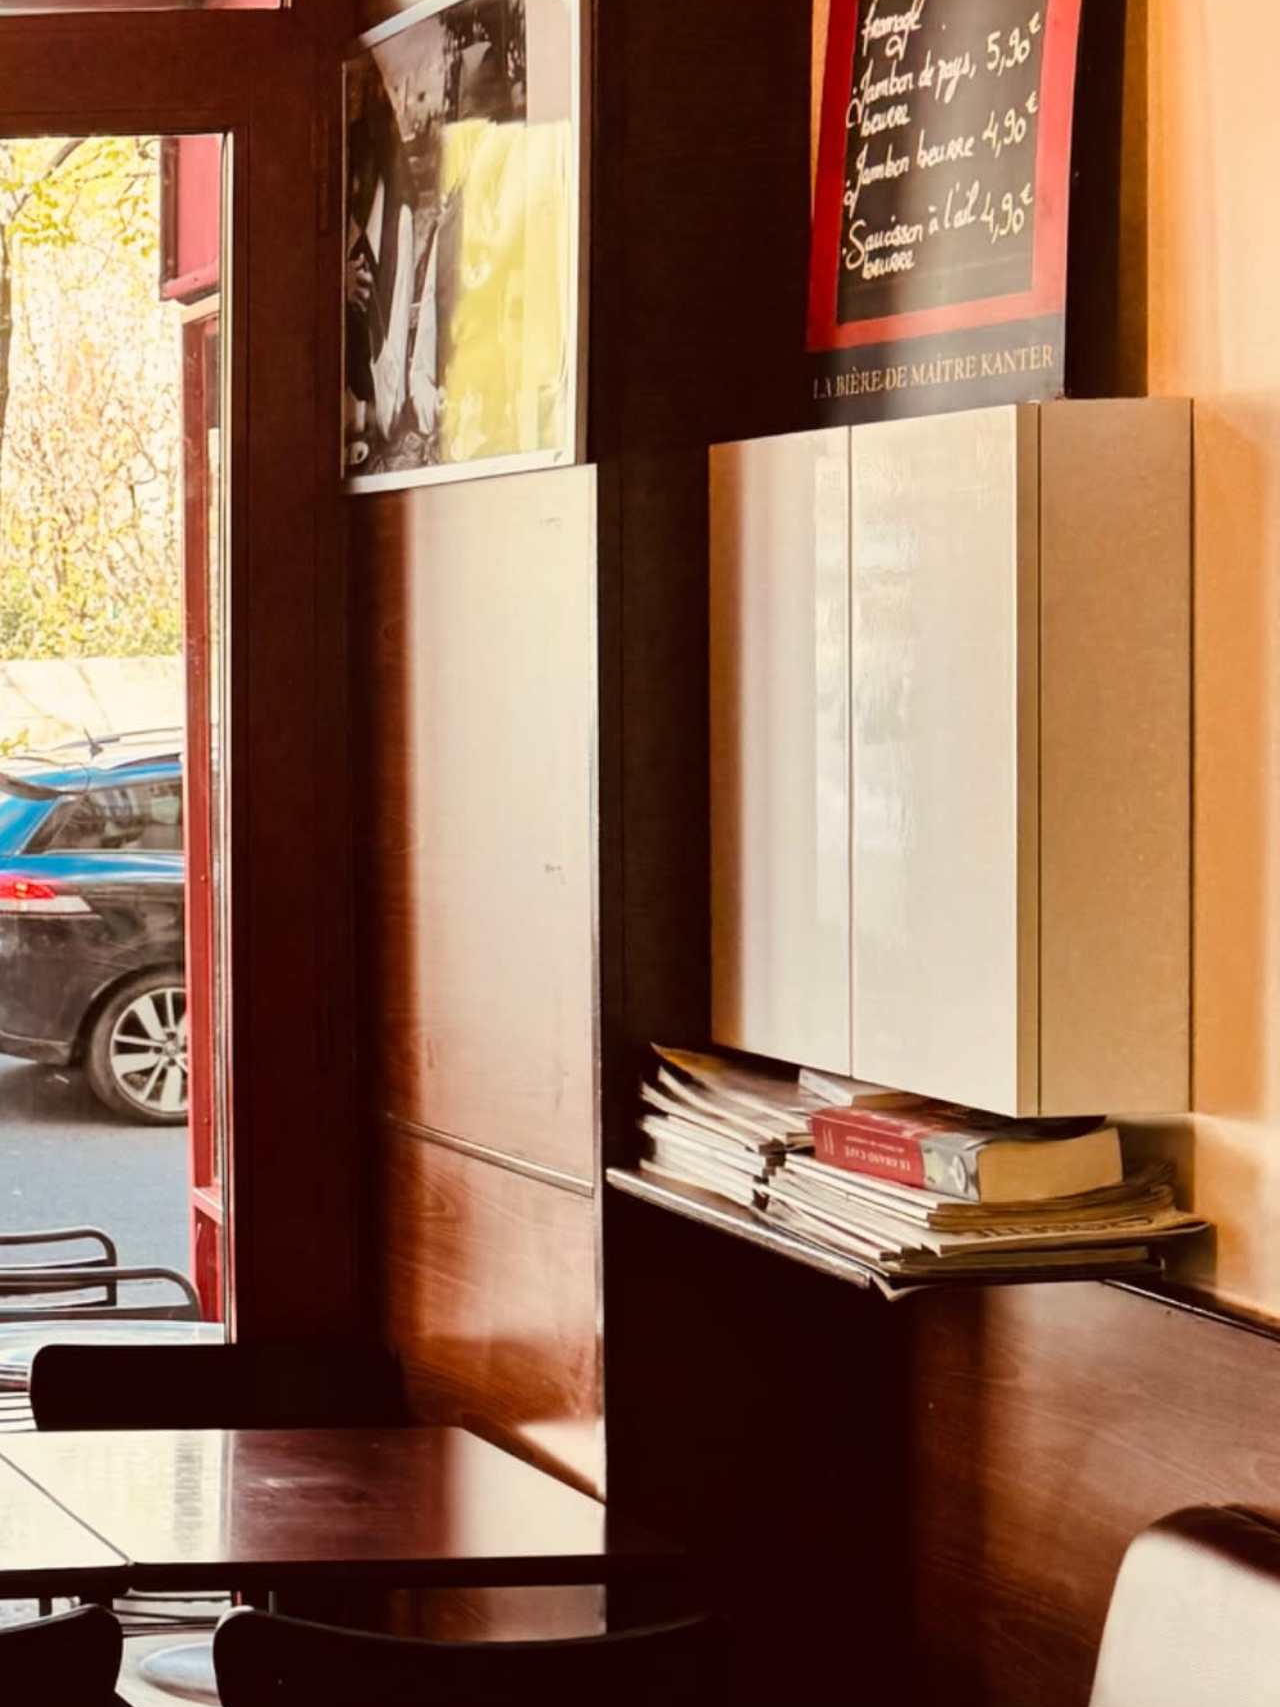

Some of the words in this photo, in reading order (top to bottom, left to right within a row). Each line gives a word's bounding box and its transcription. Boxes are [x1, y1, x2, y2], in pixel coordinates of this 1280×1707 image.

[919, 51, 934, 87] de
[917, 129, 974, 168] beurre
[929, 206, 938, 233] à
[886, 367, 907, 390] DE
[981, 344, 1055, 376] KANTER
